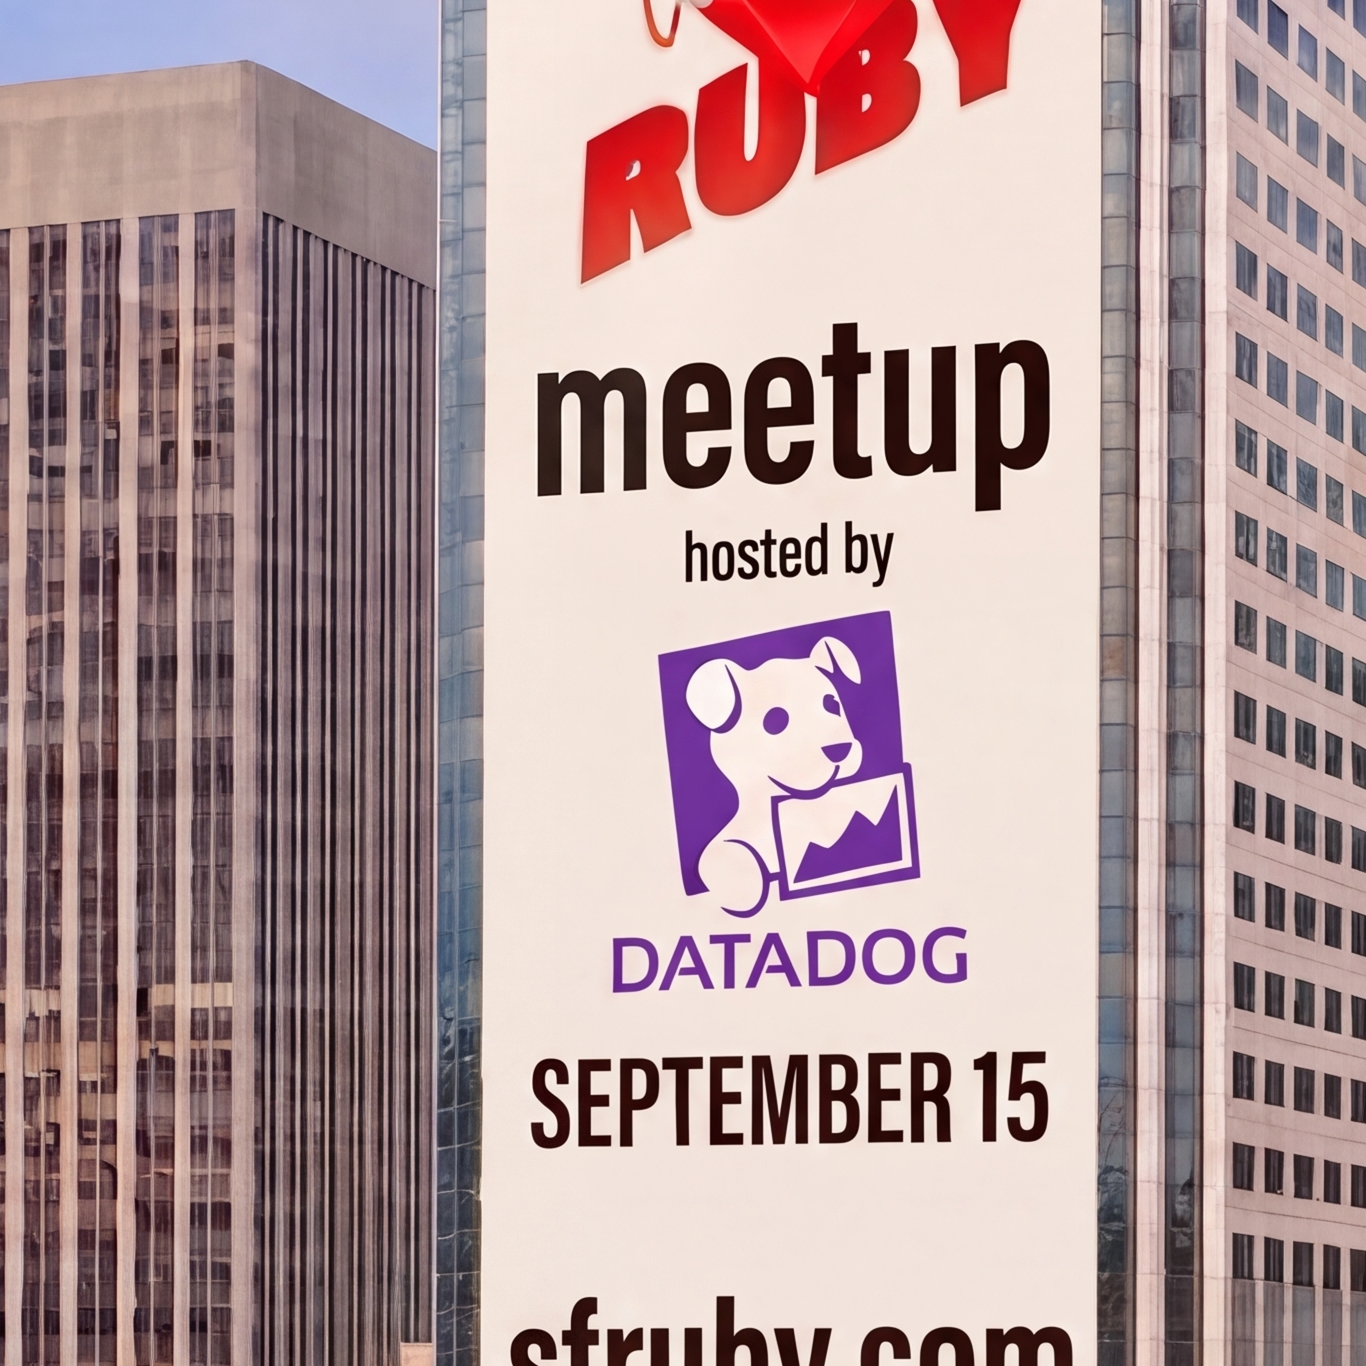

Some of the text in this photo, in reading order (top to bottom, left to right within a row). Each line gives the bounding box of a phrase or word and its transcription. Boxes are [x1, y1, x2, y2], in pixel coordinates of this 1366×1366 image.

[537, 322, 1051, 513] meetup
[685, 520, 895, 588] hosted by
[612, 926, 968, 993] DATADOG
[530, 1050, 1049, 1150] SEPTEMBER 15
